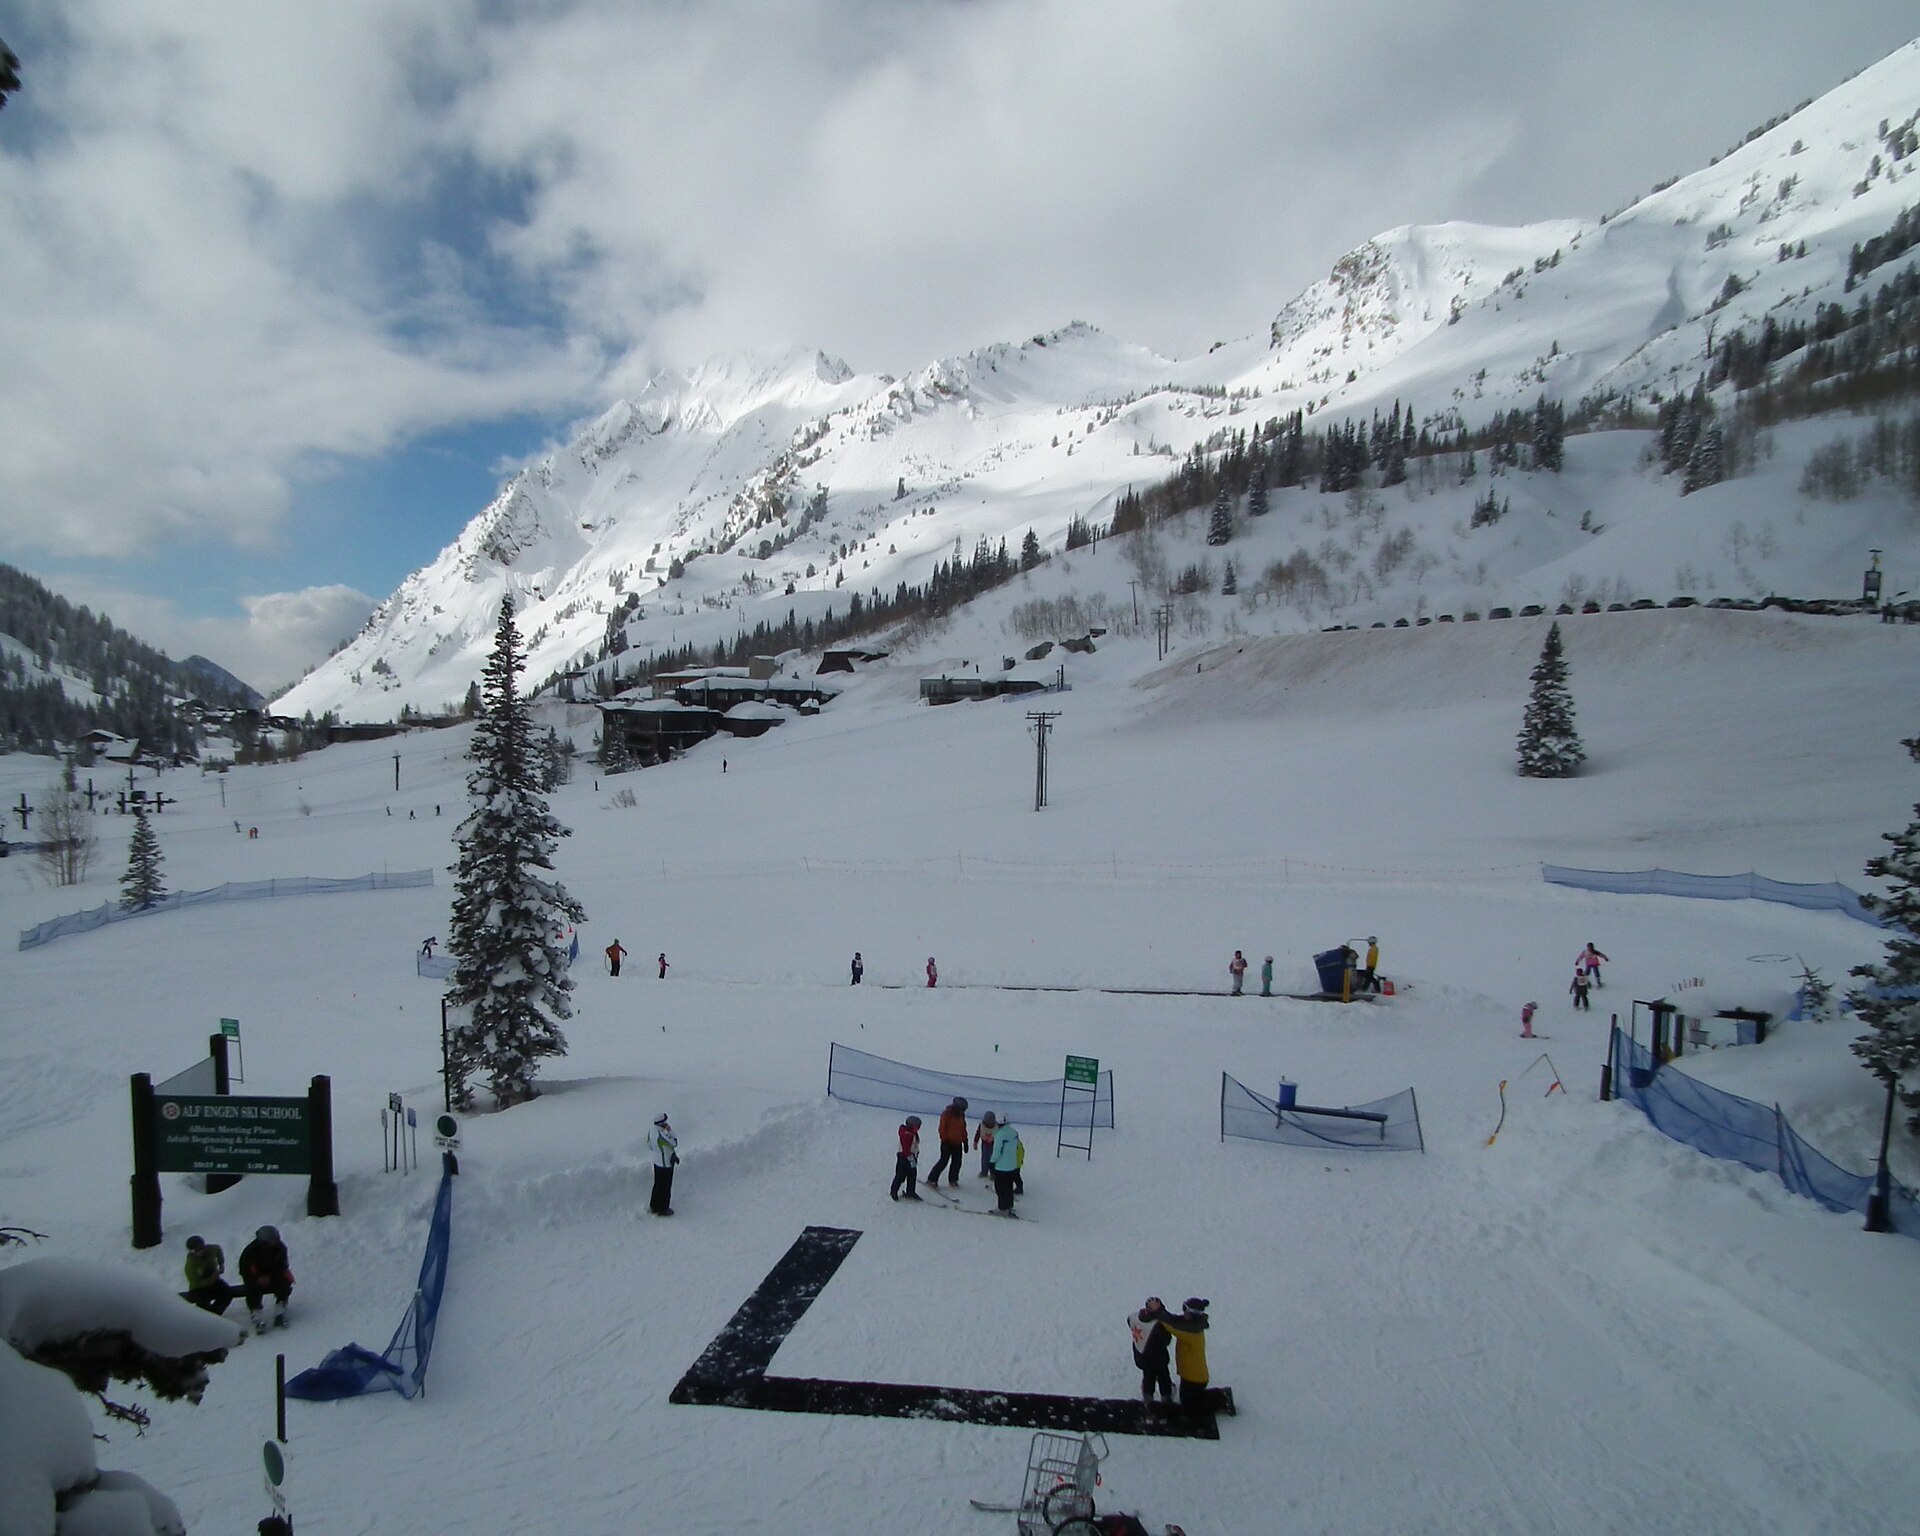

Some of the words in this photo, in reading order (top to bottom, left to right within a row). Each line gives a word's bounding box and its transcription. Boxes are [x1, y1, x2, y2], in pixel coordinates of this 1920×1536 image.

[182, 1105, 201, 1118] ALF
[204, 1105, 240, 1118] ENGEN
[241, 1106, 258, 1119] SKI
[260, 1106, 302, 1120] SCHOOL
[218, 1125, 252, 1136] Meeting
[191, 1135, 234, 1145] Beginning
[245, 1136, 299, 1146] Intermediate
[229, 1145, 261, 1154] Lessons
